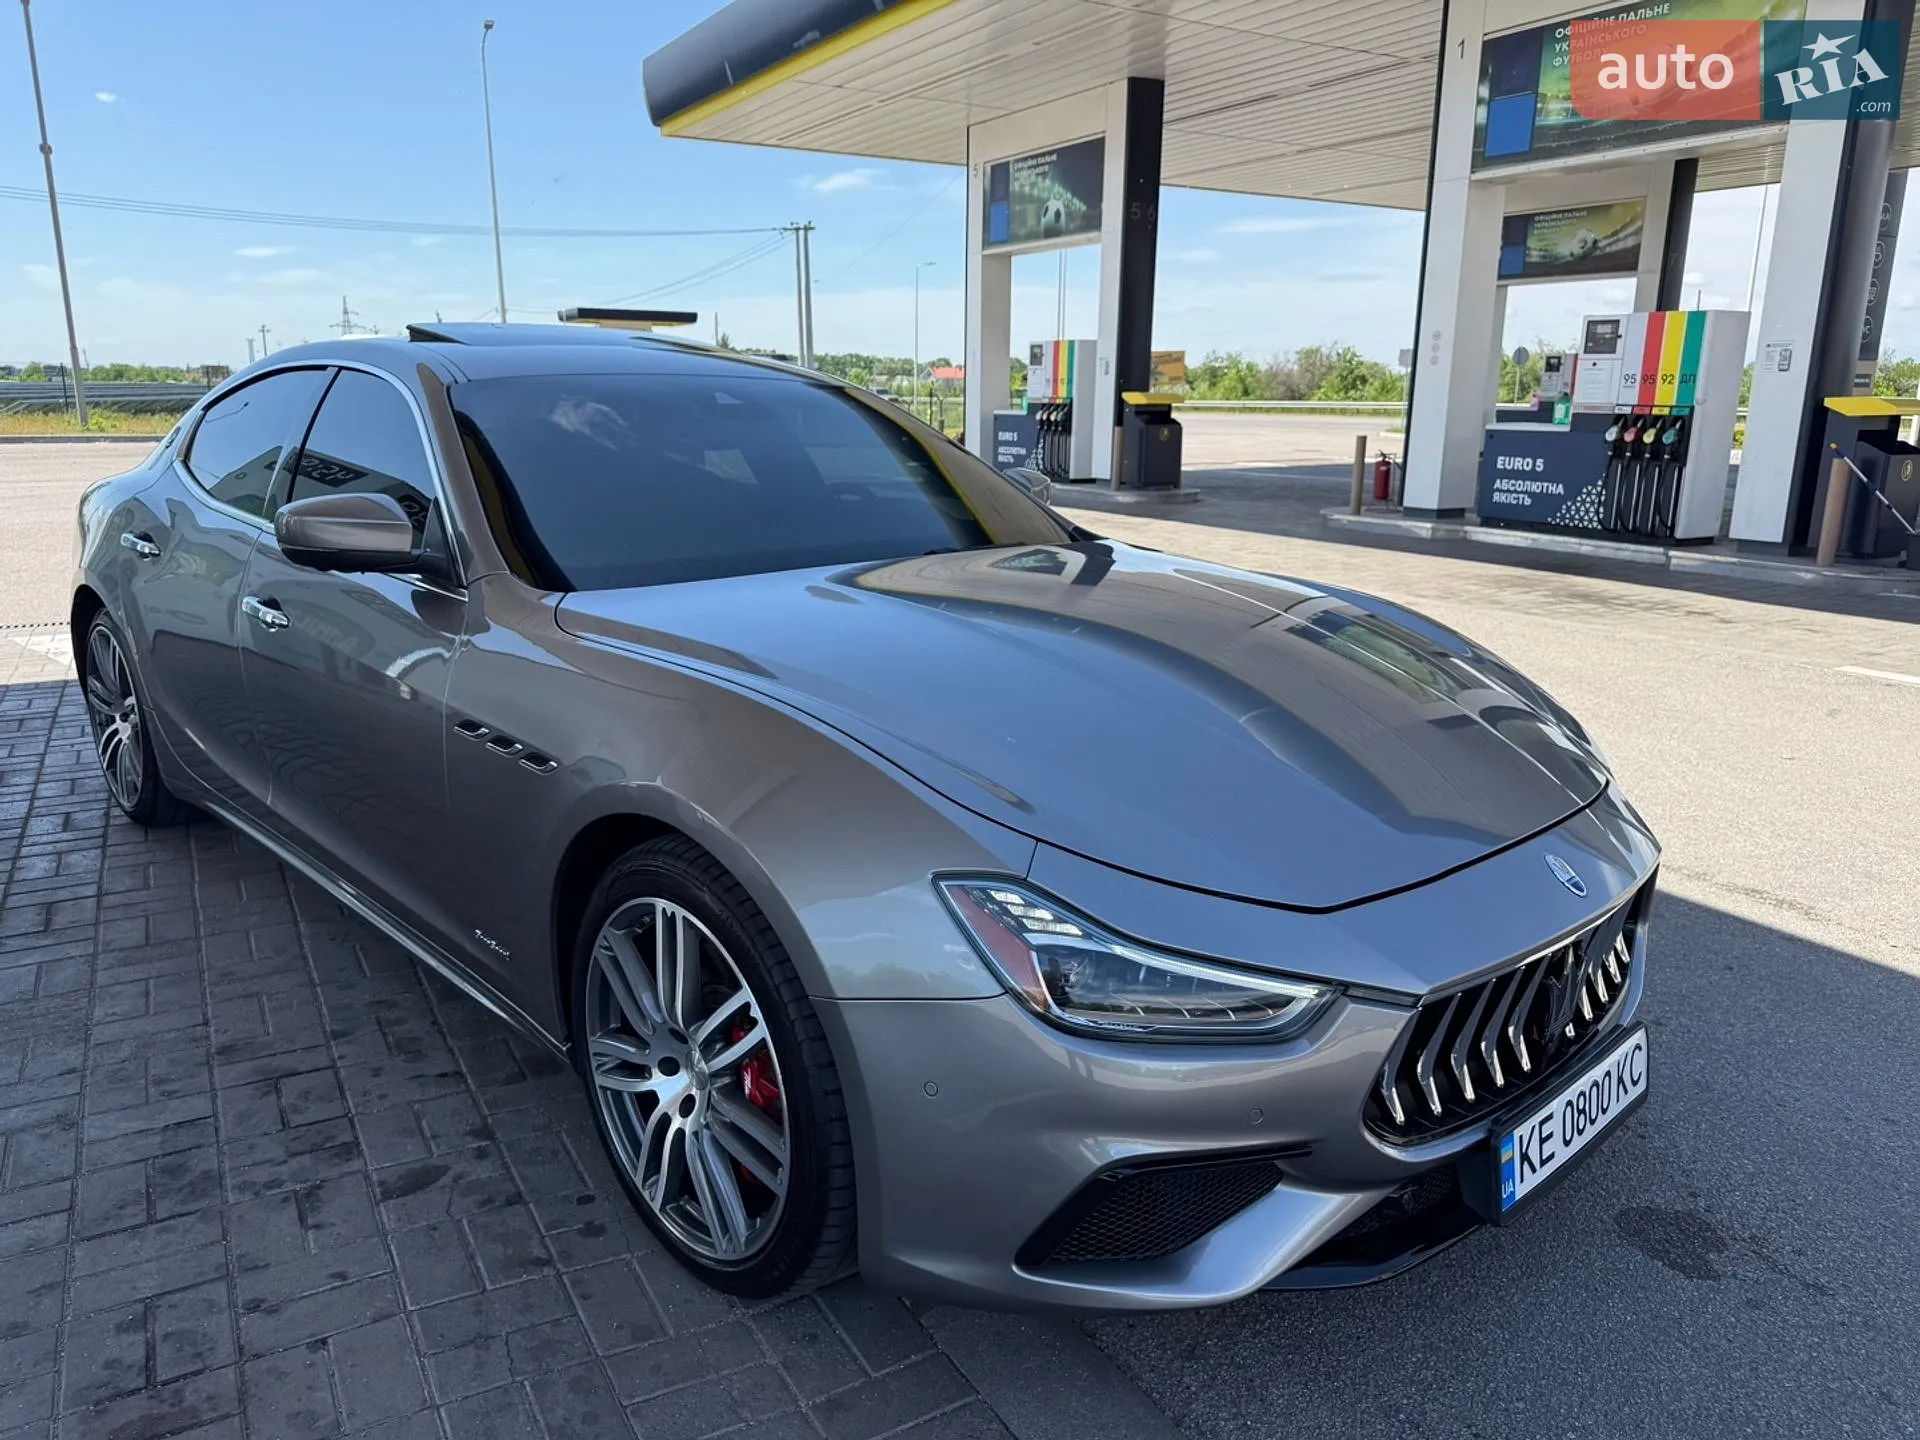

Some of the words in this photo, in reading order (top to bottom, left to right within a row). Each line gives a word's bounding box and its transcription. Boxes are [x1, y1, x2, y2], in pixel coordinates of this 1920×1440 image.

[1554, 16, 1617, 39] ОФІЦІЙНЕ
[1618, 3, 1671, 22] ПАЛЬНЕ
[1131, 203, 1141, 219] 5
[1623, 373, 1637, 385] 95
[1642, 373, 1656, 385] 95
[1660, 373, 1675, 386] 92
[1496, 456, 1533, 471] EURO
[1535, 458, 1544, 472] 5
[1493, 478, 1564, 495] АБСОЛЮТНА
[1492, 491, 1531, 506] ЯКІСТЬ
[1518, 1111, 1556, 1185] KE
[1562, 1069, 1612, 1147] 0800
[1616, 1042, 1643, 1105] KC
[1501, 1177, 1515, 1198] UA
